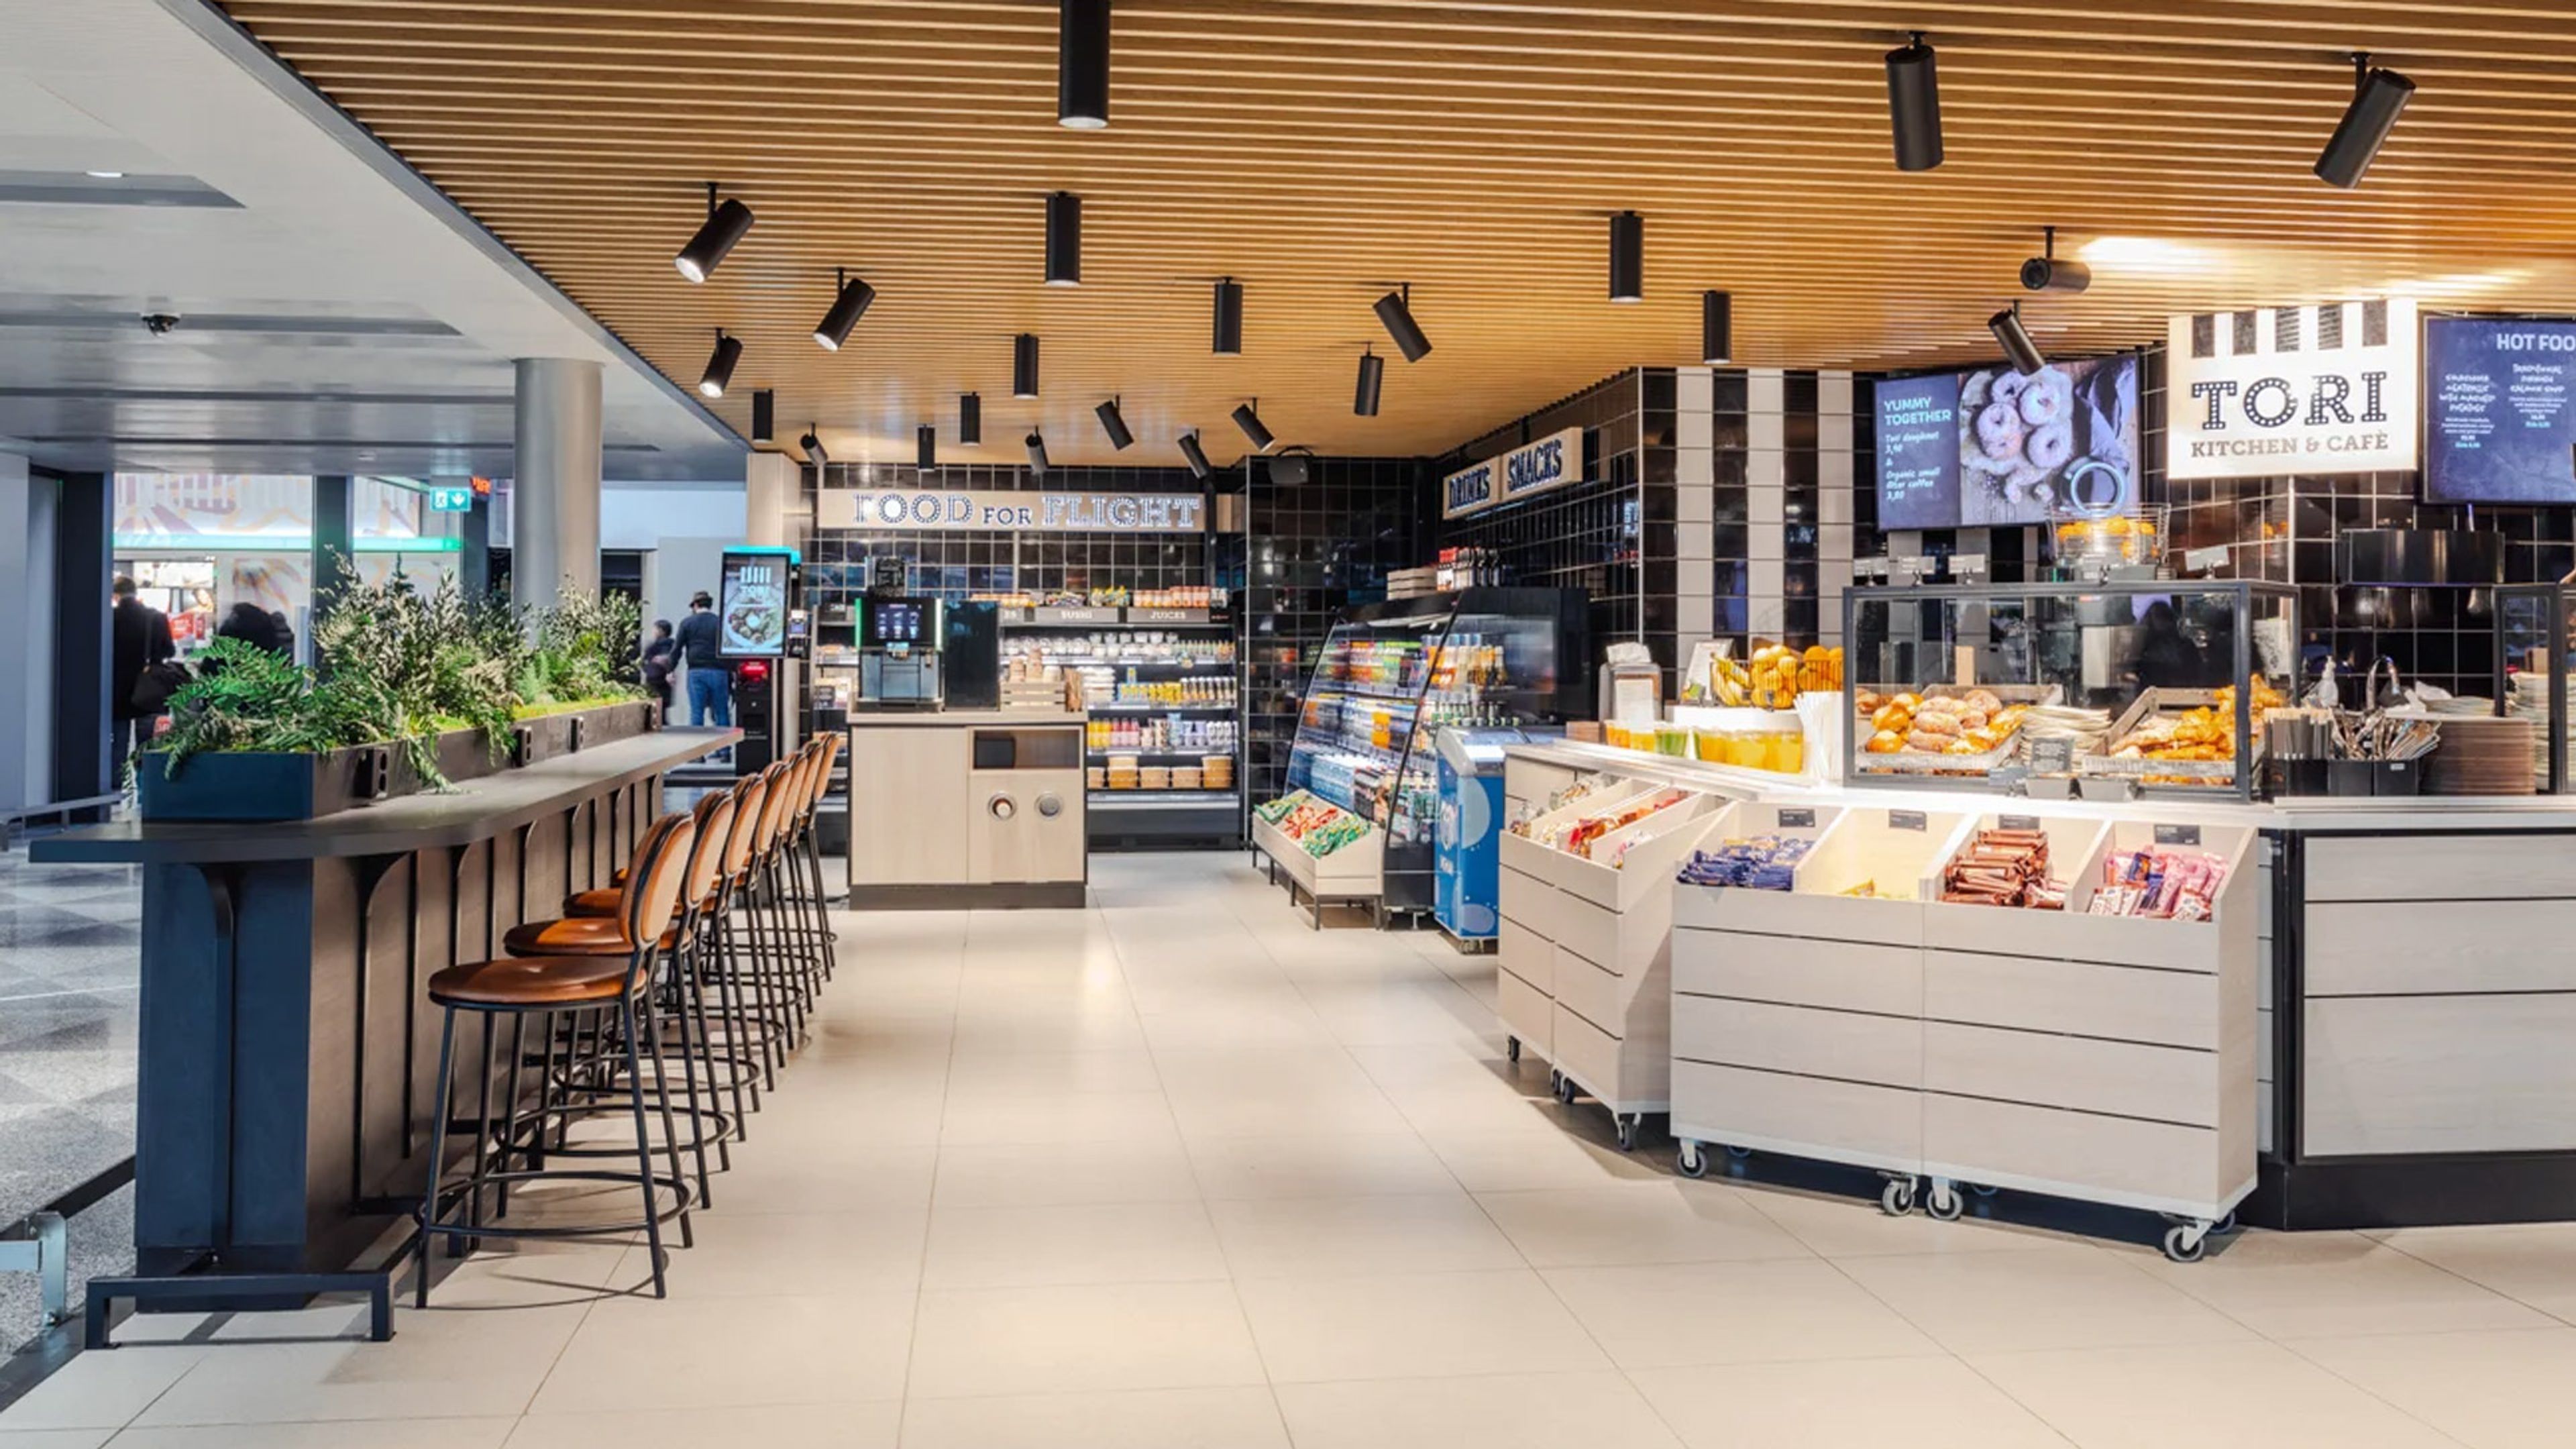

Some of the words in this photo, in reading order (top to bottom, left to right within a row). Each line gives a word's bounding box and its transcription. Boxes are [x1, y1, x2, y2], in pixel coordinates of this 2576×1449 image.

[2496, 333, 2535, 351] HOT
[2538, 335, 2576, 351] FOO
[1884, 397, 1931, 411] YUMMY
[2191, 371, 2387, 430] TORI
[1884, 410, 1951, 425] TOGETHER
[2191, 437, 2298, 458] KITCHEN
[2305, 437, 2319, 452] &
[1507, 439, 1562, 492] SNACKS
[853, 493, 973, 523] FOOD
[983, 507, 1031, 524] FOR
[1042, 495, 1200, 527] FLIGHT
[1150, 610, 1186, 620] JUICES
